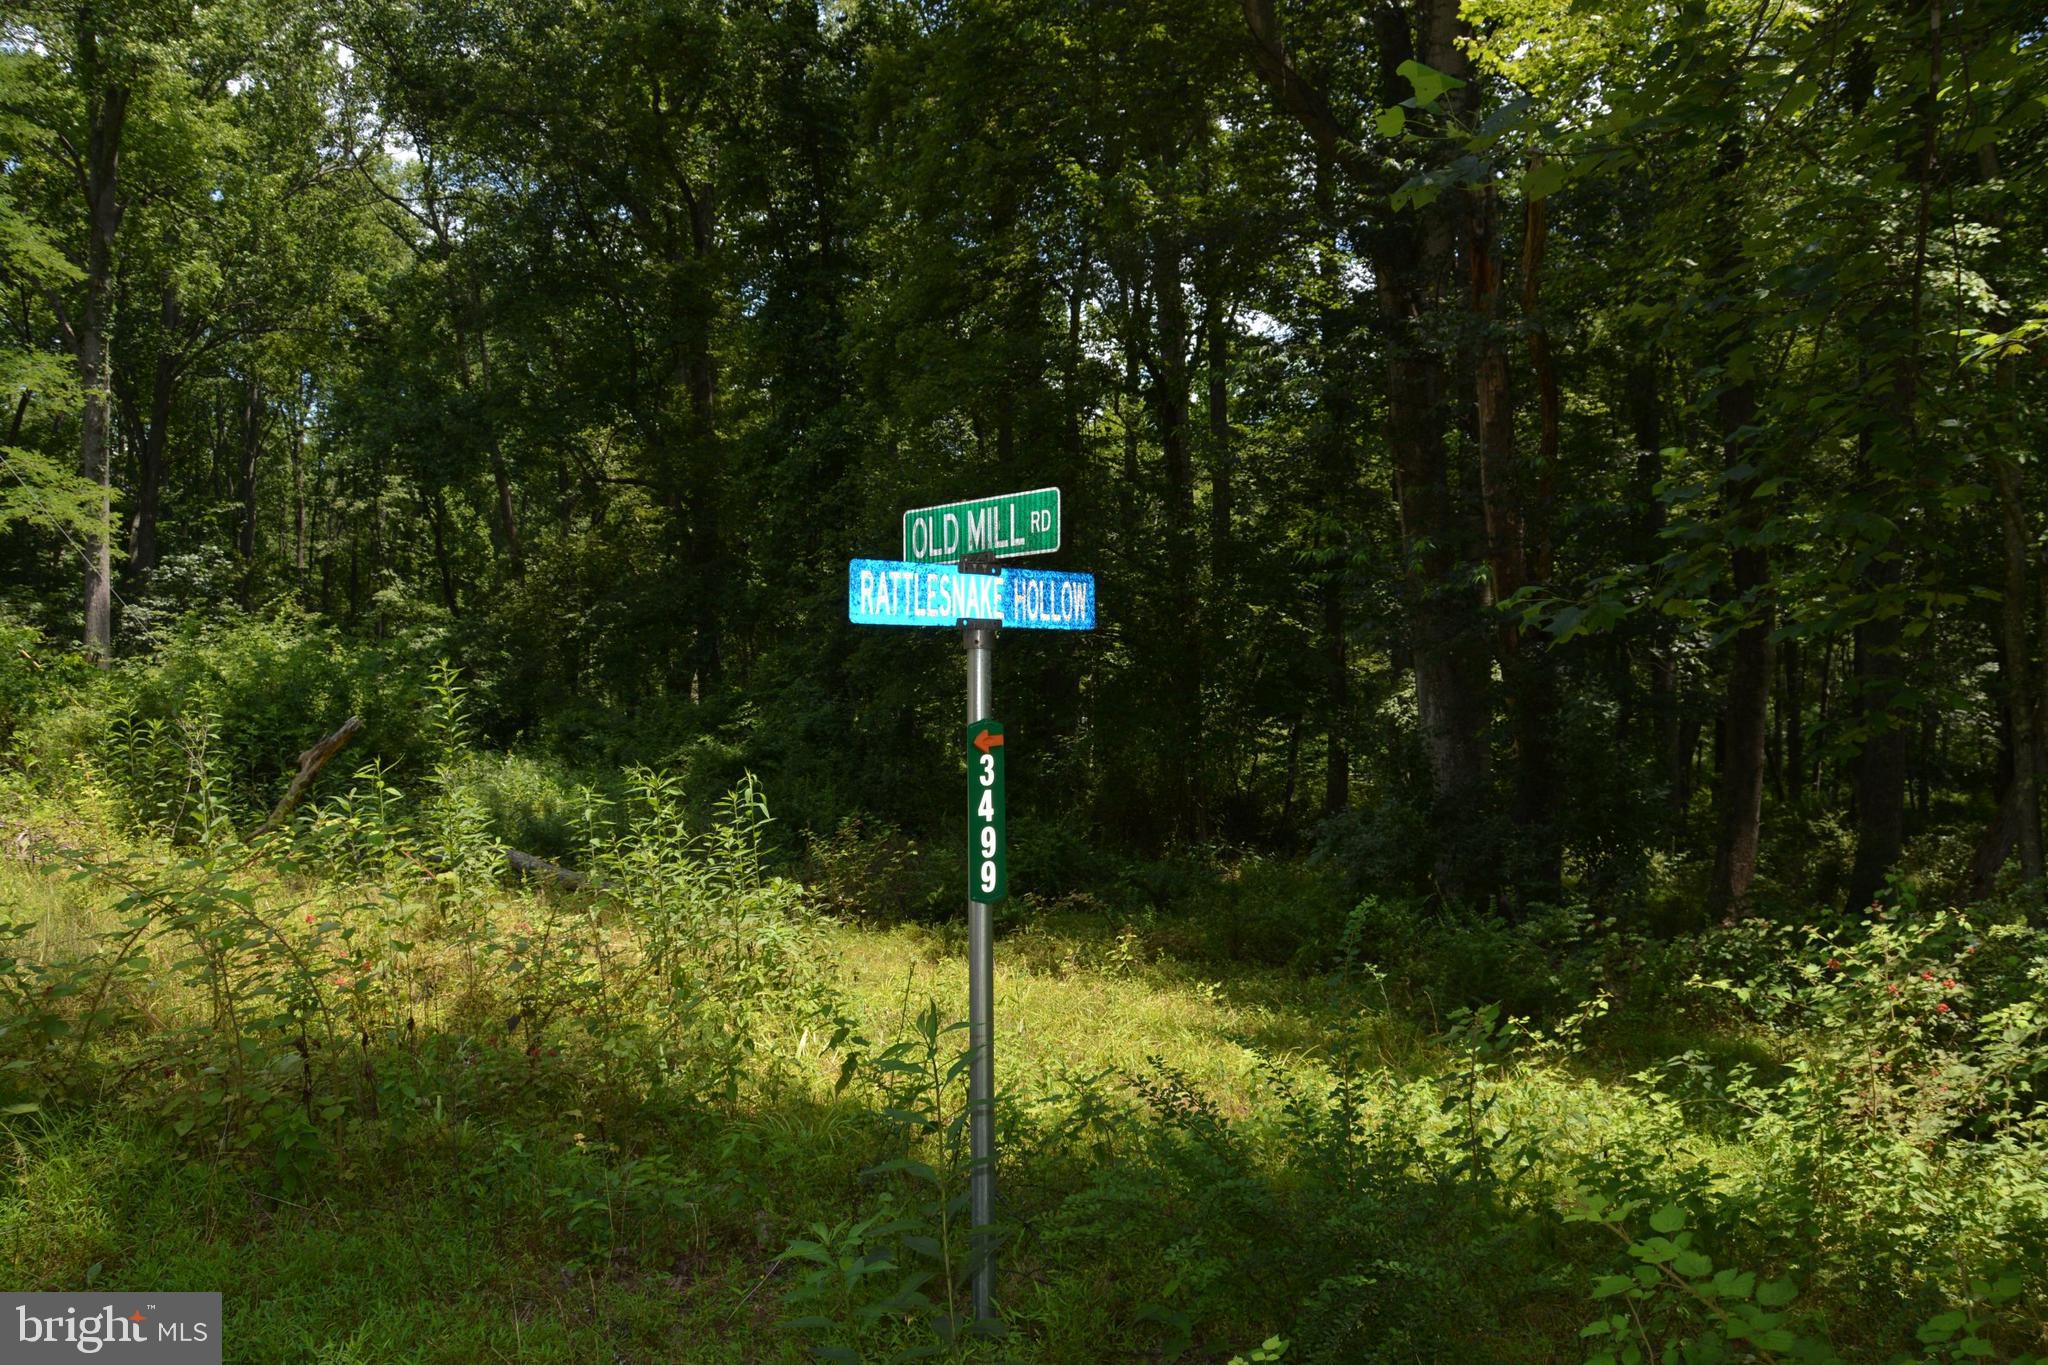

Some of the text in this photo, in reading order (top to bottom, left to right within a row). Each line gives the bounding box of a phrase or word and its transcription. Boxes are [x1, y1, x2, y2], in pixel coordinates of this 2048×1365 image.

[912, 503, 1052, 559] OLD MILL RD
[860, 569, 1087, 623] RATTLESNAKE HOLLOW
[977, 753, 997, 893] 3499
